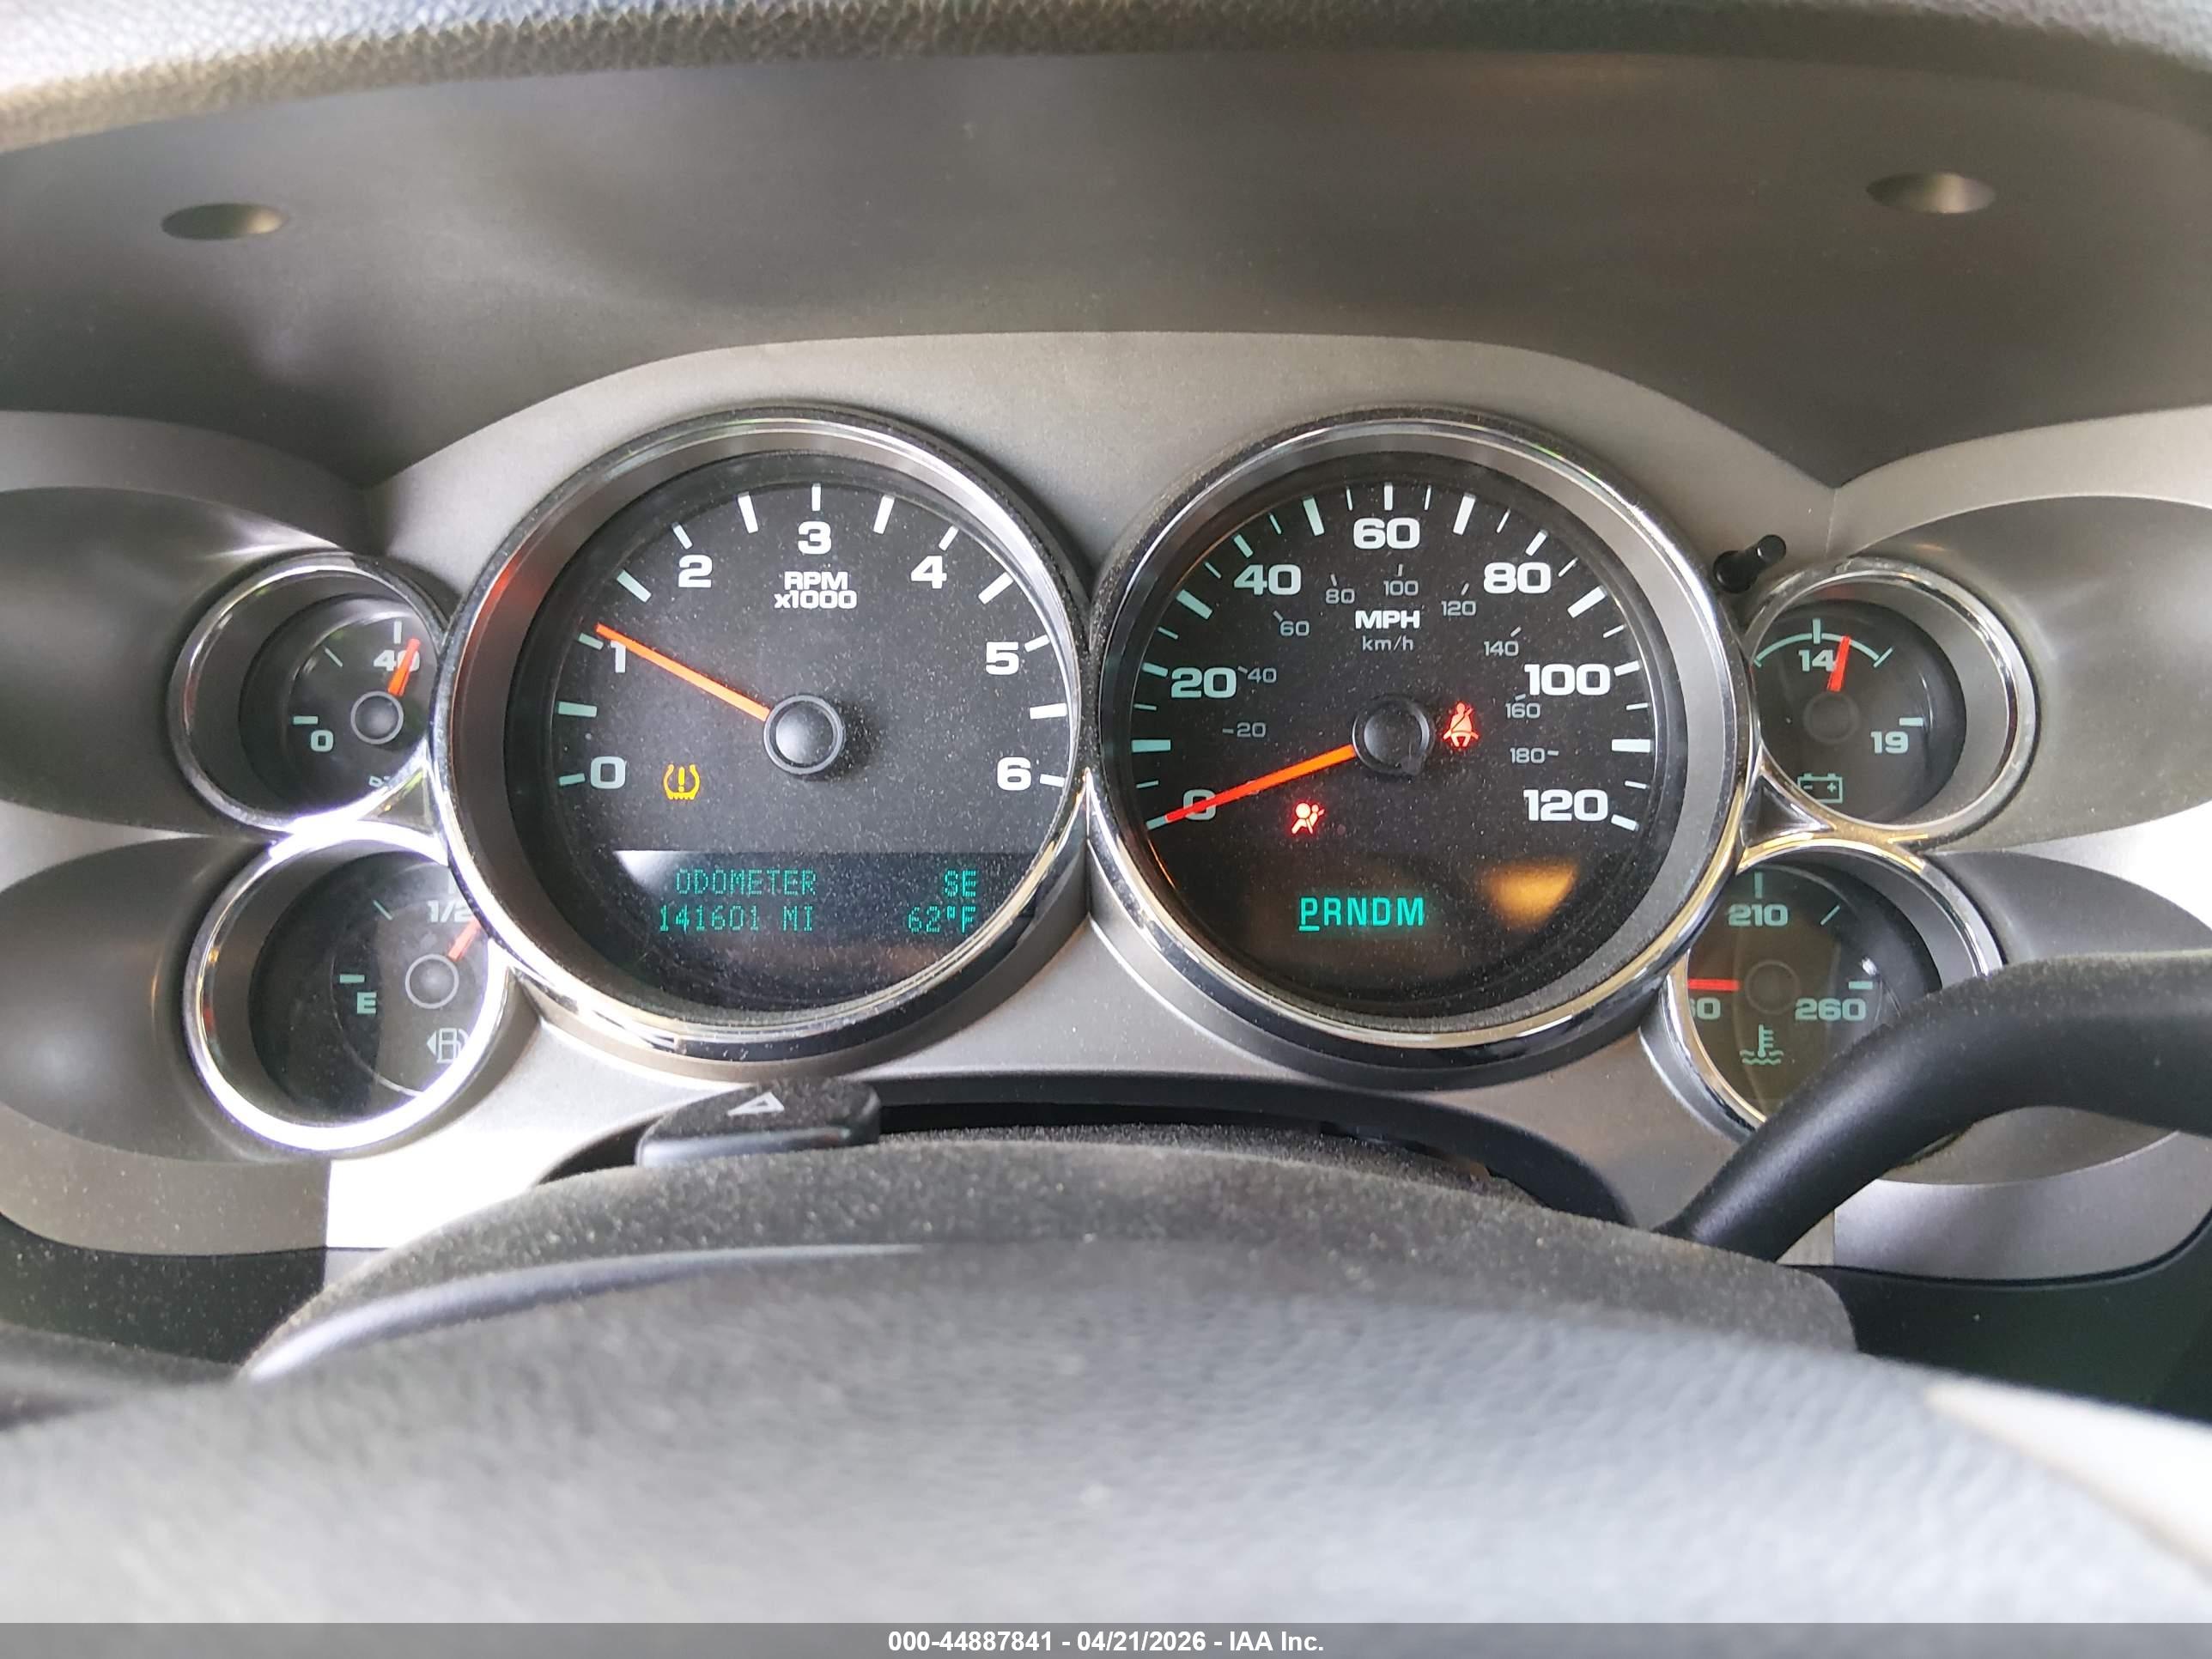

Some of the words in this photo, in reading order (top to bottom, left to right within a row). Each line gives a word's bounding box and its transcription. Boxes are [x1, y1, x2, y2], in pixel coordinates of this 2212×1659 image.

[799, 521, 832, 555] 3
[1352, 517, 1421, 550] 60
[678, 555, 713, 588] 2
[784, 571, 848, 591] RPM
[911, 556, 947, 590] 4
[1233, 564, 1301, 595] 40
[1483, 562, 1551, 594] 80
[1325, 588, 1356, 605] 80
[1382, 580, 1419, 596] 100
[774, 590, 857, 610] x1000
[1441, 600, 1477, 617] 120
[1279, 620, 1310, 637] 60
[1354, 611, 1420, 629] MPH
[1361, 635, 1413, 653] km/h
[1483, 641, 1519, 657] 140
[373, 649, 420, 672] 40
[611, 641, 627, 673] 1
[985, 641, 1020, 675] 5
[1798, 649, 1836, 672] 14
[1171, 667, 1237, 698] 20
[1246, 667, 1277, 684] 40
[1523, 664, 1610, 696] 100
[1505, 702, 1540, 719] 160
[310, 730, 334, 752] 0
[1237, 723, 1267, 738] 20
[1870, 731, 1909, 754] 19
[1510, 748, 1545, 763] 180
[590, 756, 626, 789] 0
[996, 757, 1031, 791] 6
[1183, 789, 1216, 821] 0
[1523, 789, 1608, 822] 120
[675, 869, 817, 896] ODOMETER
[944, 870, 976, 897] SE
[428, 900, 473, 923] 1/2
[659, 905, 758, 932] 141601
[782, 906, 813, 932] MI
[1299, 896, 1425, 932] PRNDM
[1728, 903, 1789, 927] 210
[357, 992, 377, 1014] E
[1795, 998, 1867, 1021] 260
